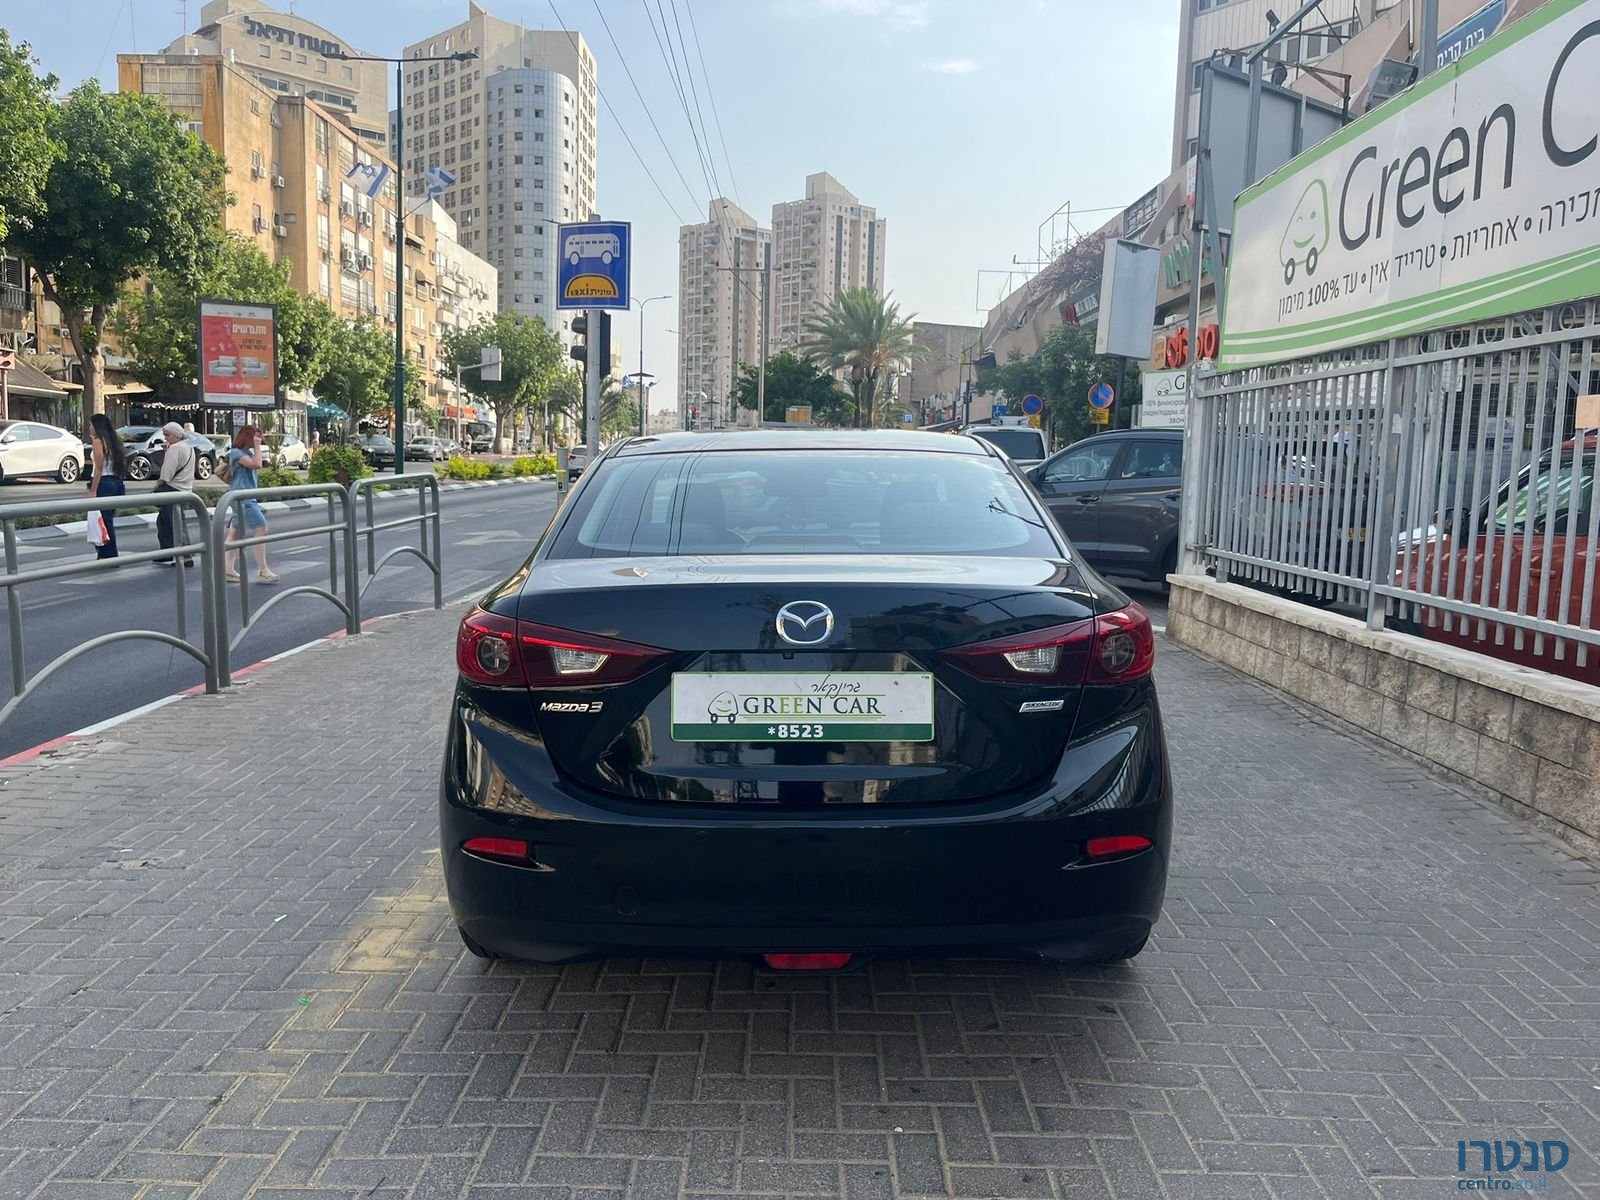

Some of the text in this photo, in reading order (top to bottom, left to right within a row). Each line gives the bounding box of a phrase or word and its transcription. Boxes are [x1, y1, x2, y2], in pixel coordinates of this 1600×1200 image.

[243, 15, 296, 46] דניאל
[1465, 28, 1485, 50] בית
[1338, 103, 1516, 251] Green
[1451, 215, 1519, 261] אחריות
[1395, 243, 1436, 278] טרייד
[1307, 278, 1340, 307] 100%
[1343, 272, 1358, 295] עד
[1369, 260, 1390, 294] אין
[1278, 291, 1304, 322] מימון
[743, 697, 882, 715] GREEN CAR
